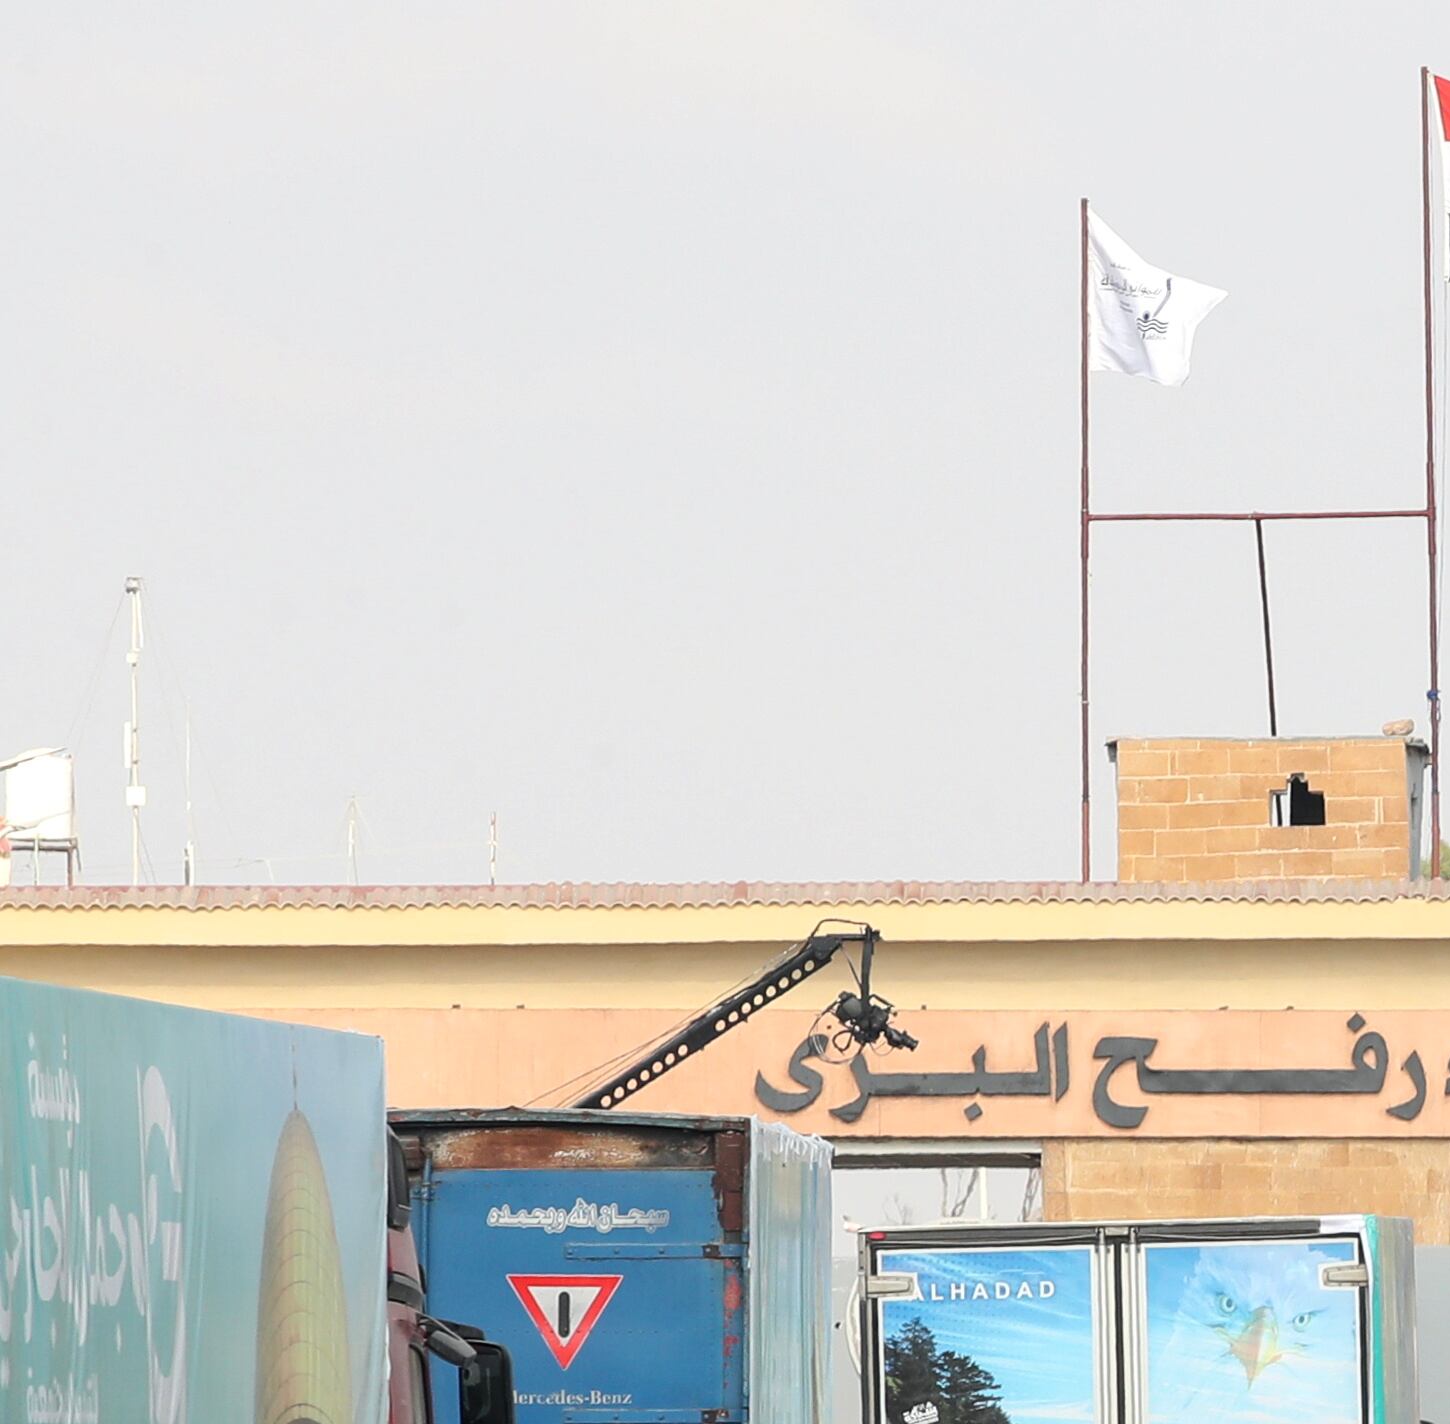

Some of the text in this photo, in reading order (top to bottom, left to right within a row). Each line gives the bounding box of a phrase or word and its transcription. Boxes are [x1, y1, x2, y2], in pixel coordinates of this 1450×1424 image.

[1093, 1012, 1427, 1129] رفح
[487, 1197, 671, 1234] سبحان الله وبحمده
